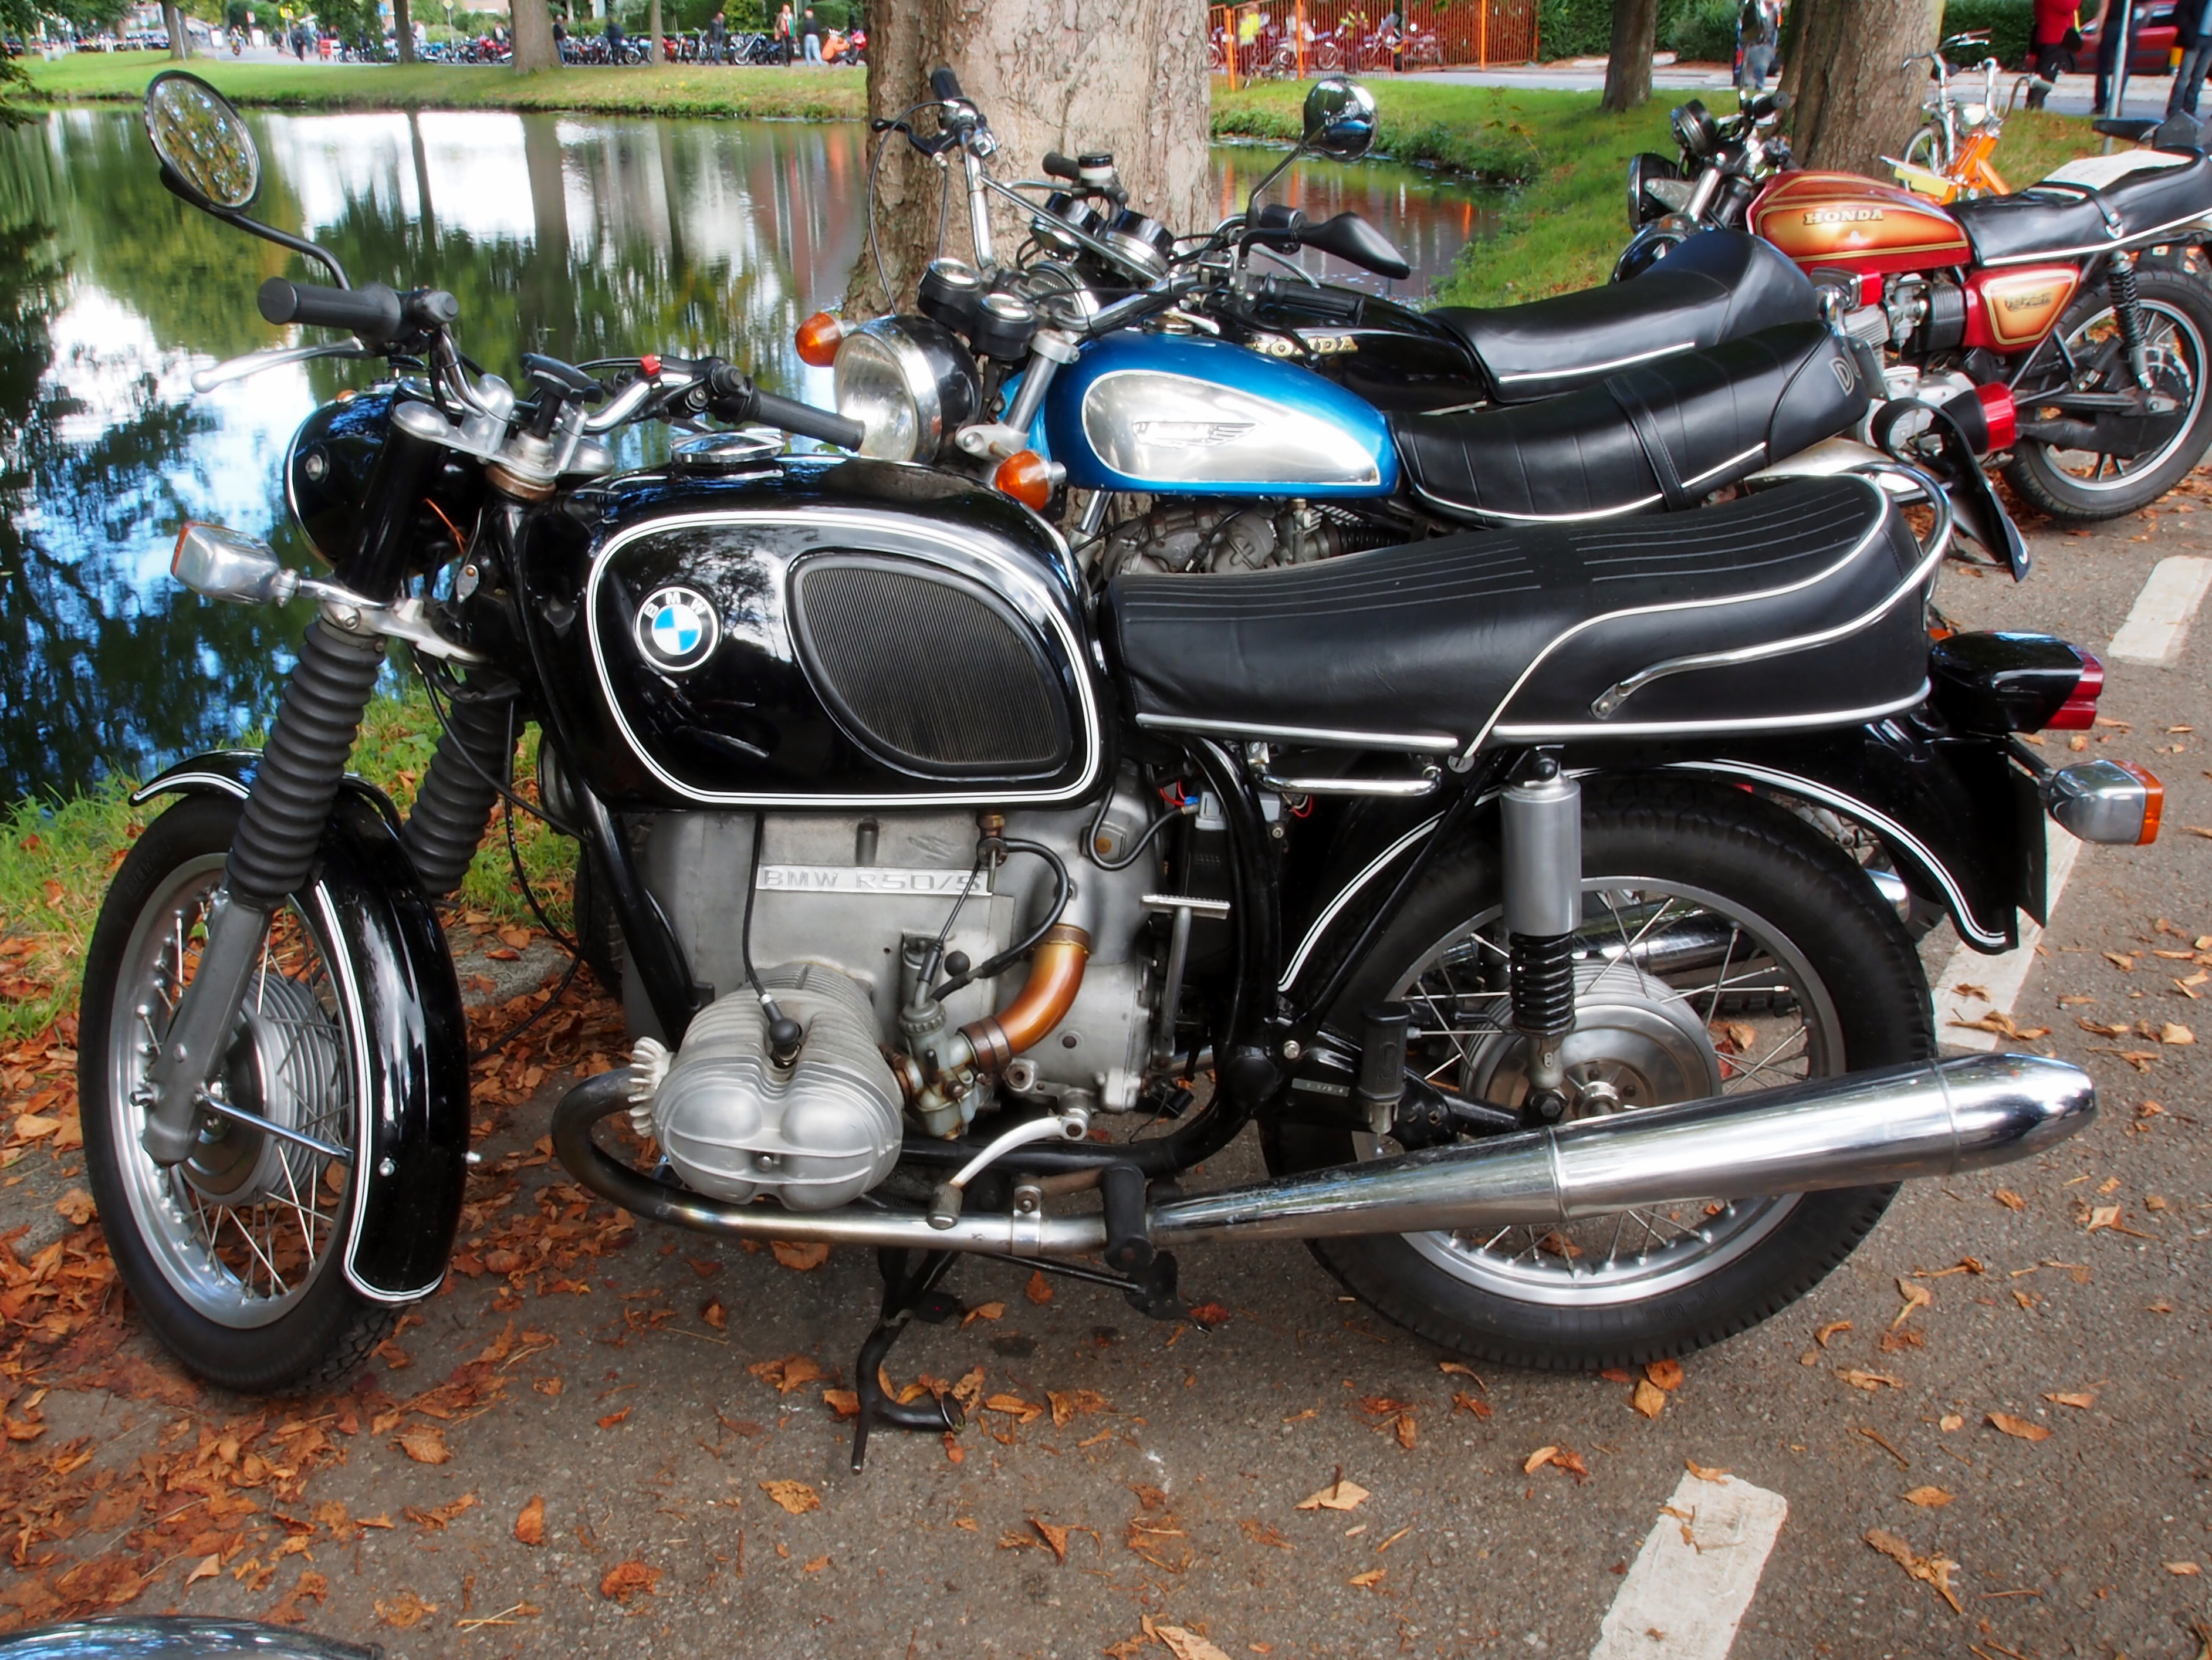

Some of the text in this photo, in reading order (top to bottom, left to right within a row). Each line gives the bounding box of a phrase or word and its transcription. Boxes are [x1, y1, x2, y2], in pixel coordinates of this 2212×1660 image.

[1804, 209, 1884, 225] HONDA
[644, 591, 706, 619] BMW
[764, 869, 981, 891] BMW R50/5
